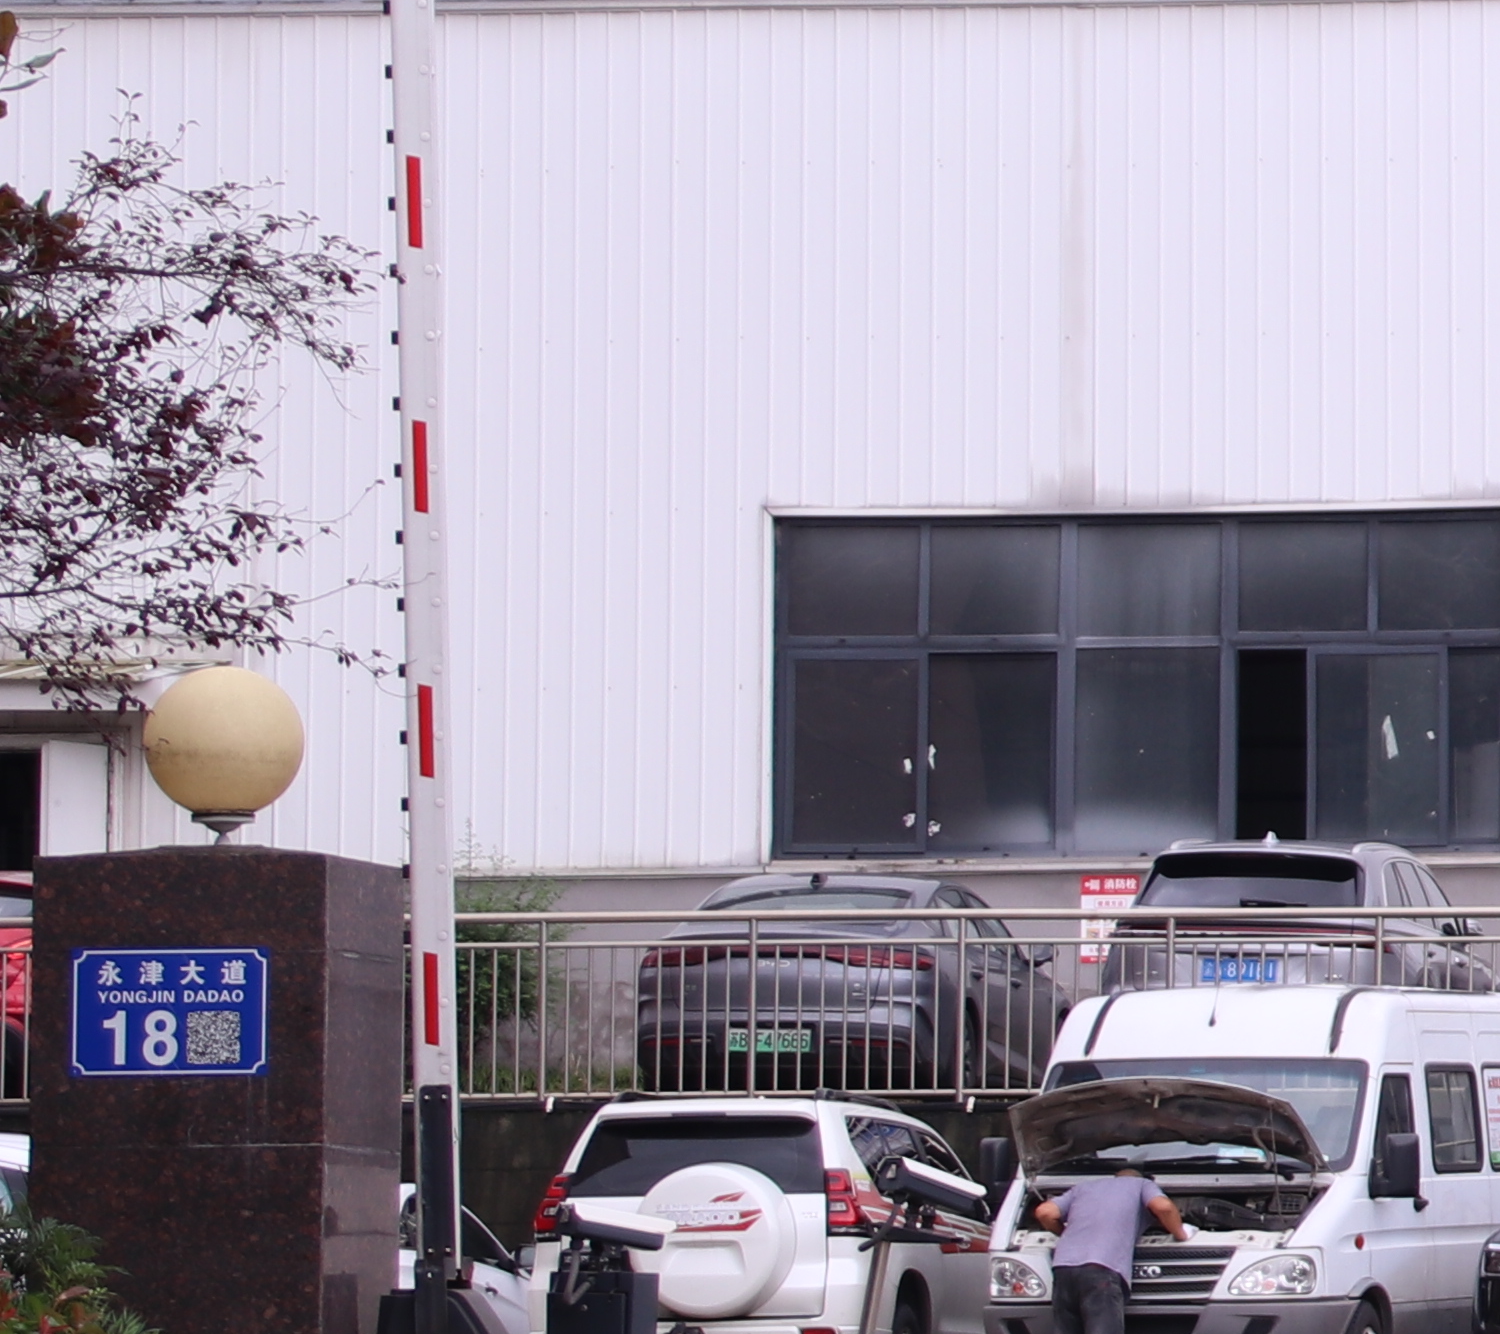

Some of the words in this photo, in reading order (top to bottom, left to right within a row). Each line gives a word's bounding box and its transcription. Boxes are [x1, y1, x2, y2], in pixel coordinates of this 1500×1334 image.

[97, 960, 247, 987] 永津大道
[98, 990, 175, 1004] YONGJIN
[183, 989, 244, 1003] DADAO
[103, 1010, 178, 1066] 18
